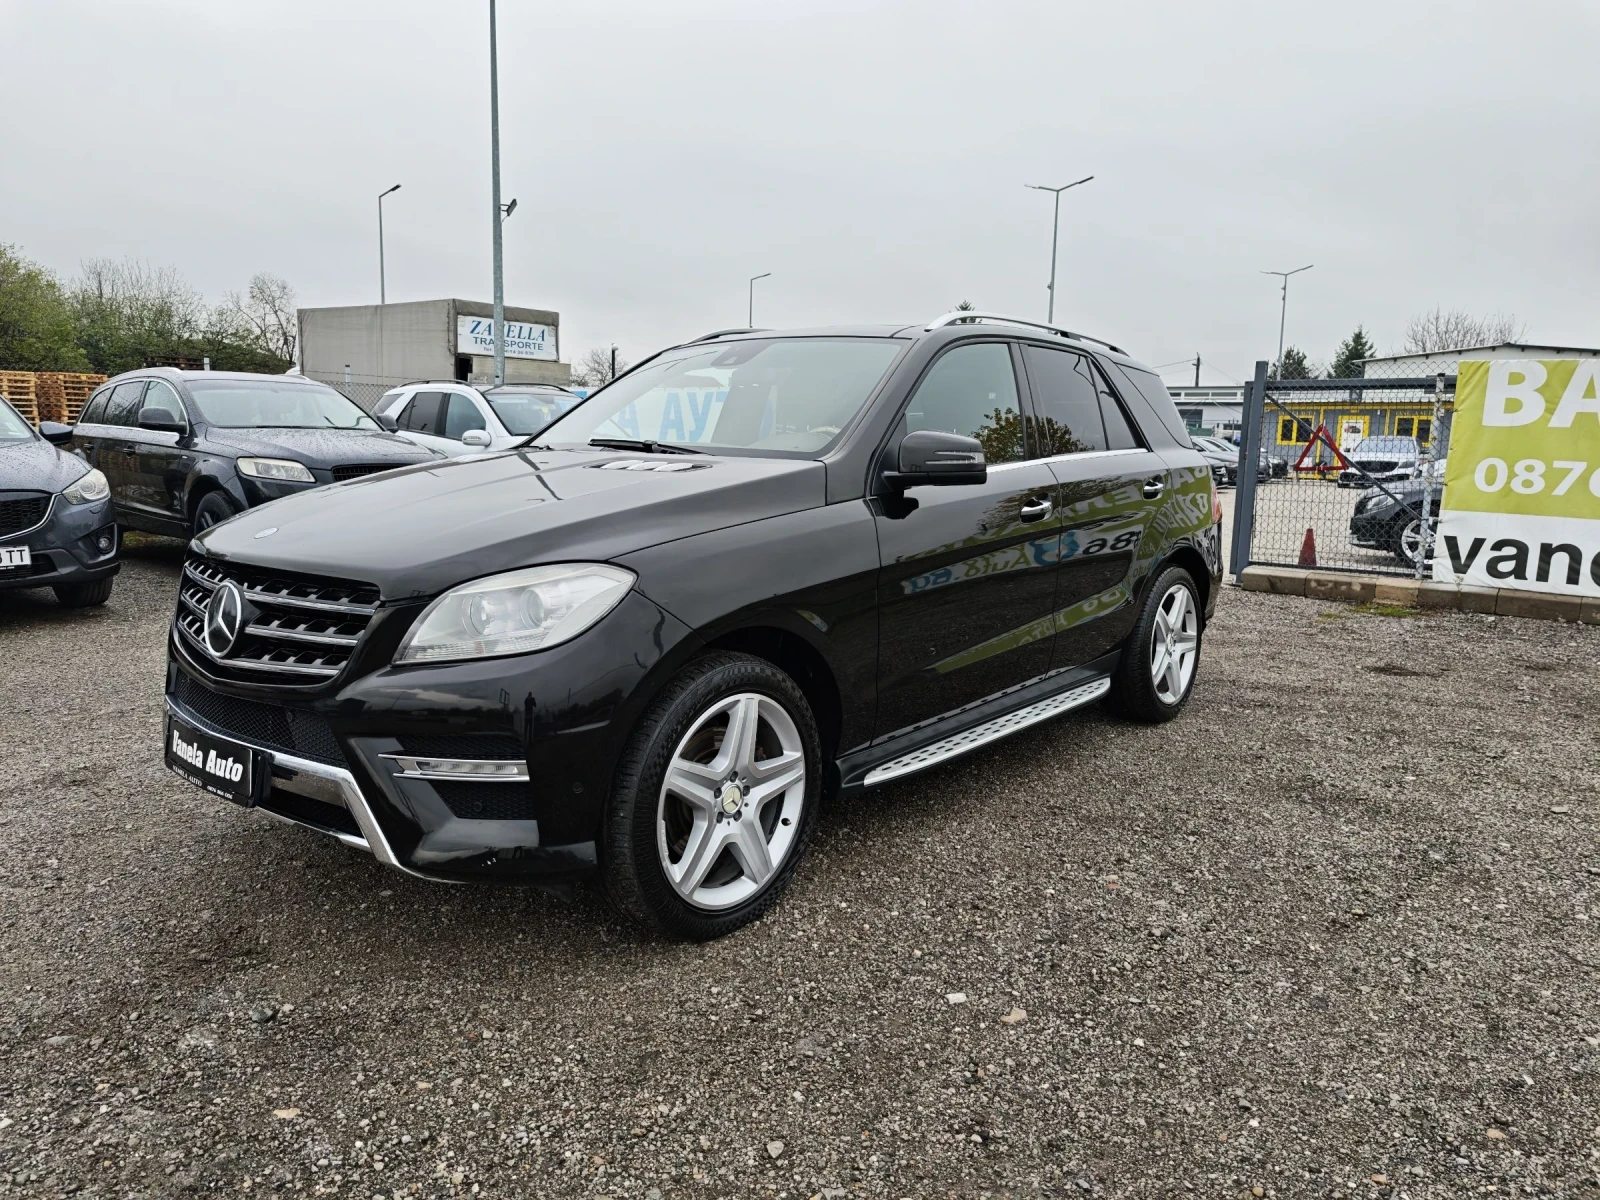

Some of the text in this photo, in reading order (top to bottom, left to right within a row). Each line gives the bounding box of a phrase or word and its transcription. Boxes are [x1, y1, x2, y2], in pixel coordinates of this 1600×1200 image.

[469, 320, 546, 342] ZAELLA
[473, 337, 544, 351] TRASPORTE
[172, 729, 244, 782] Vanela Auto
